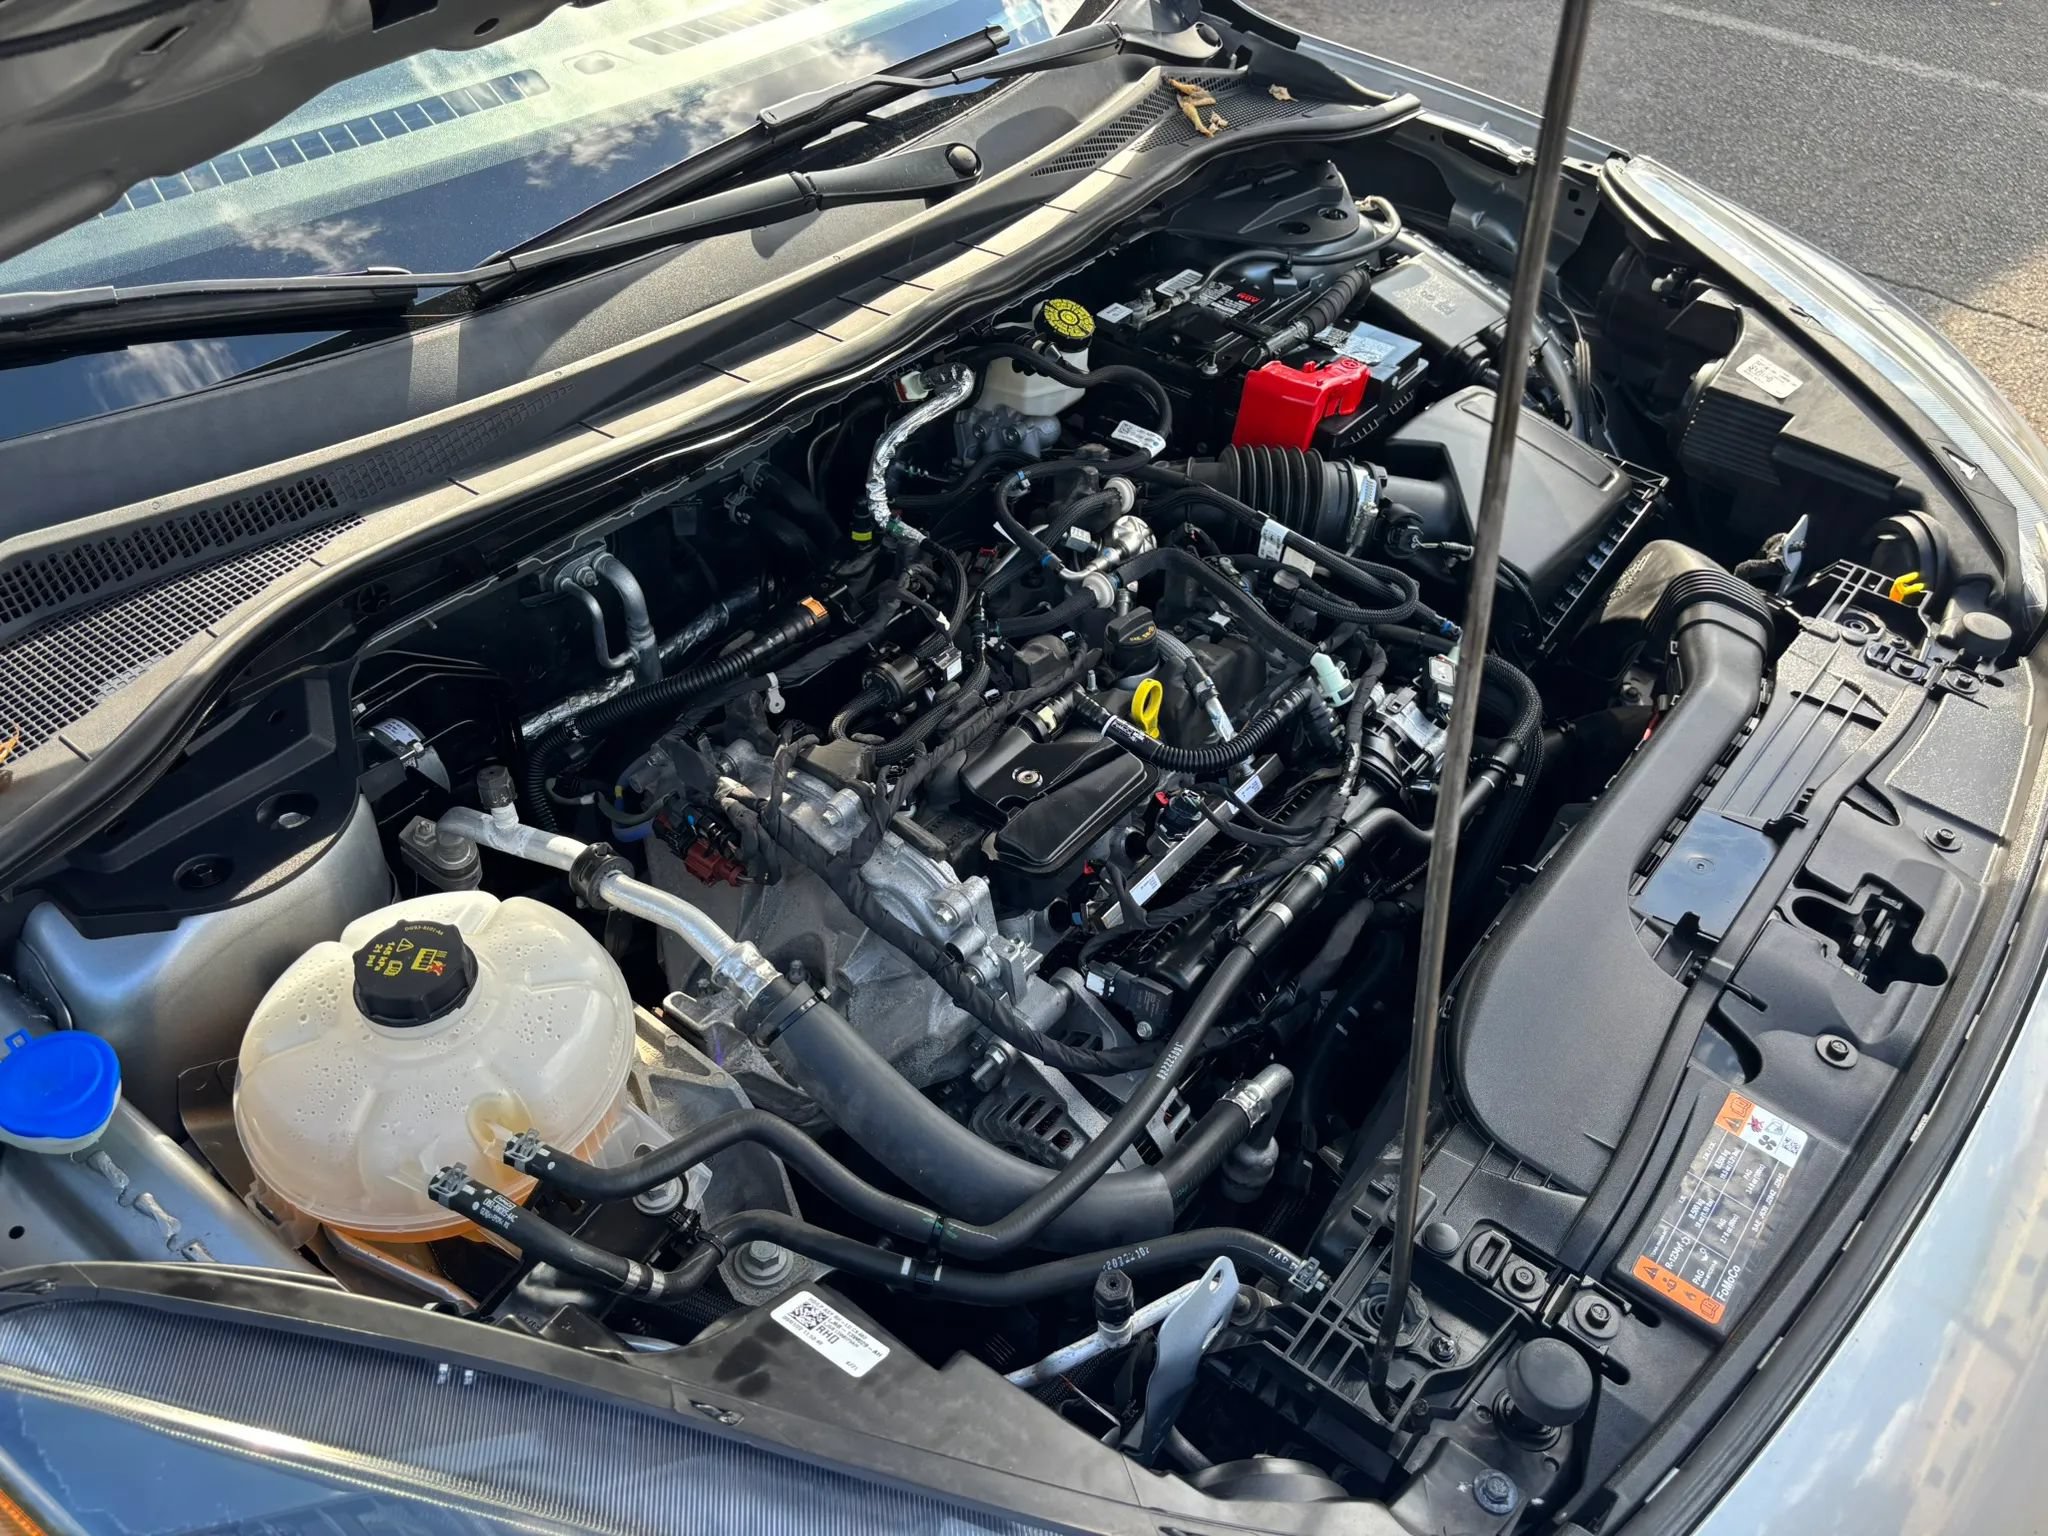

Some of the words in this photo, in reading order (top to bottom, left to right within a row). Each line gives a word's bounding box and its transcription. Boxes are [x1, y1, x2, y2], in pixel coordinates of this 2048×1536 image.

[372, 944, 383, 952] 21
[382, 942, 395, 954] 145
[373, 956, 388, 970] kPa
[1720, 1148, 1731, 1158] kg
[1742, 1168, 1753, 1180] PAG
[1687, 1204, 1700, 1219] 0.500
[1694, 1197, 1706, 1208] kg
[1715, 1217, 1727, 1230] PAG
[1751, 1219, 1762, 1232] SAE
[1757, 1205, 1769, 1219] J639
[1662, 1240, 1686, 1270] R-1234yf
[1691, 1268, 1705, 1285] PAG
[1714, 1263, 1743, 1301] FoMoCo
